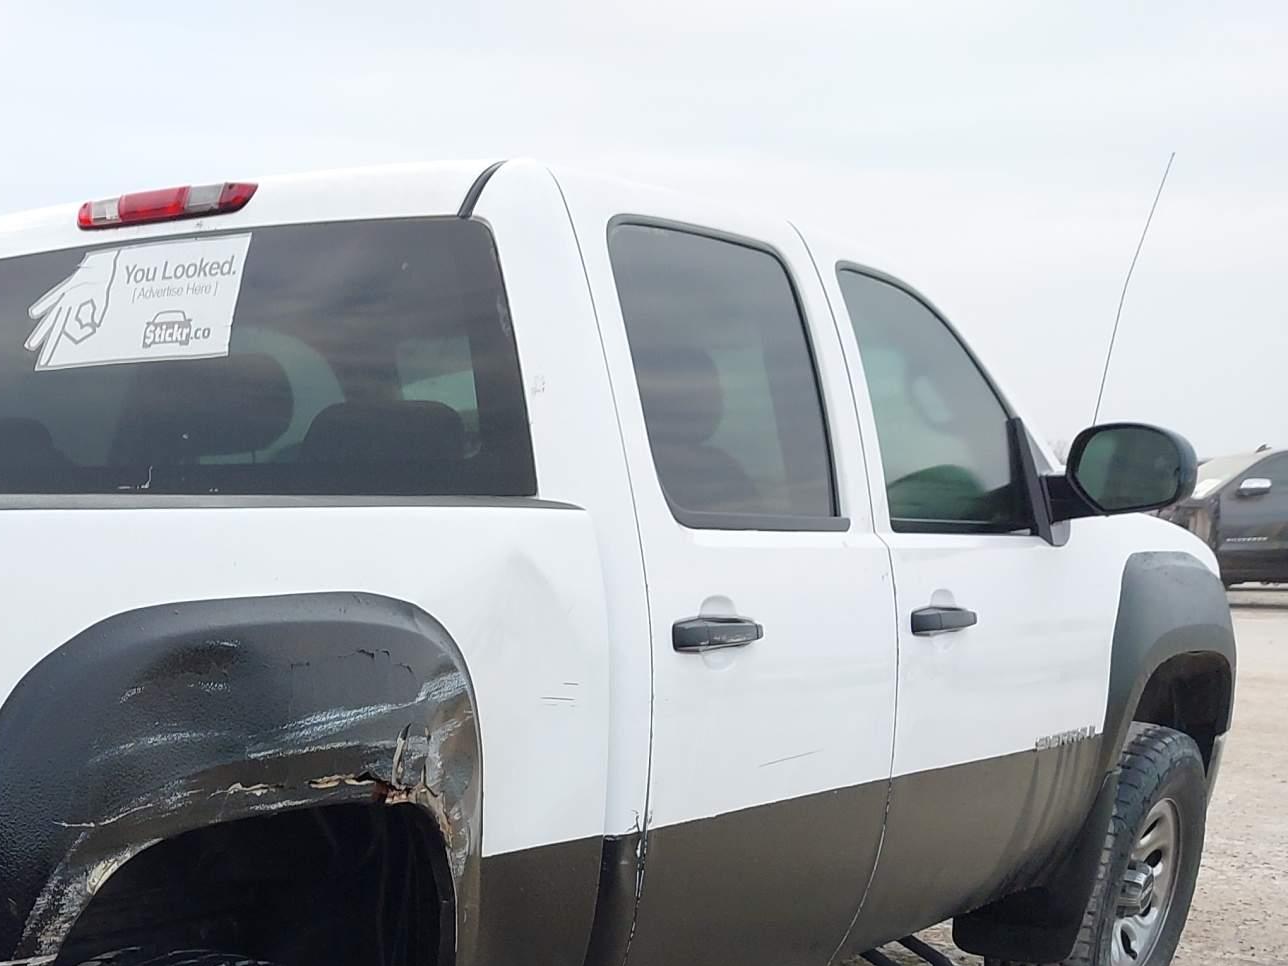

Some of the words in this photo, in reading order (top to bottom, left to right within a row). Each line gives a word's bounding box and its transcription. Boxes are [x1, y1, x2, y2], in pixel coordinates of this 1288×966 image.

[125, 264, 157, 284] You
[162, 255, 236, 280] Looked.
[137, 286, 183, 299] Advertise
[185, 282, 211, 297] Here
